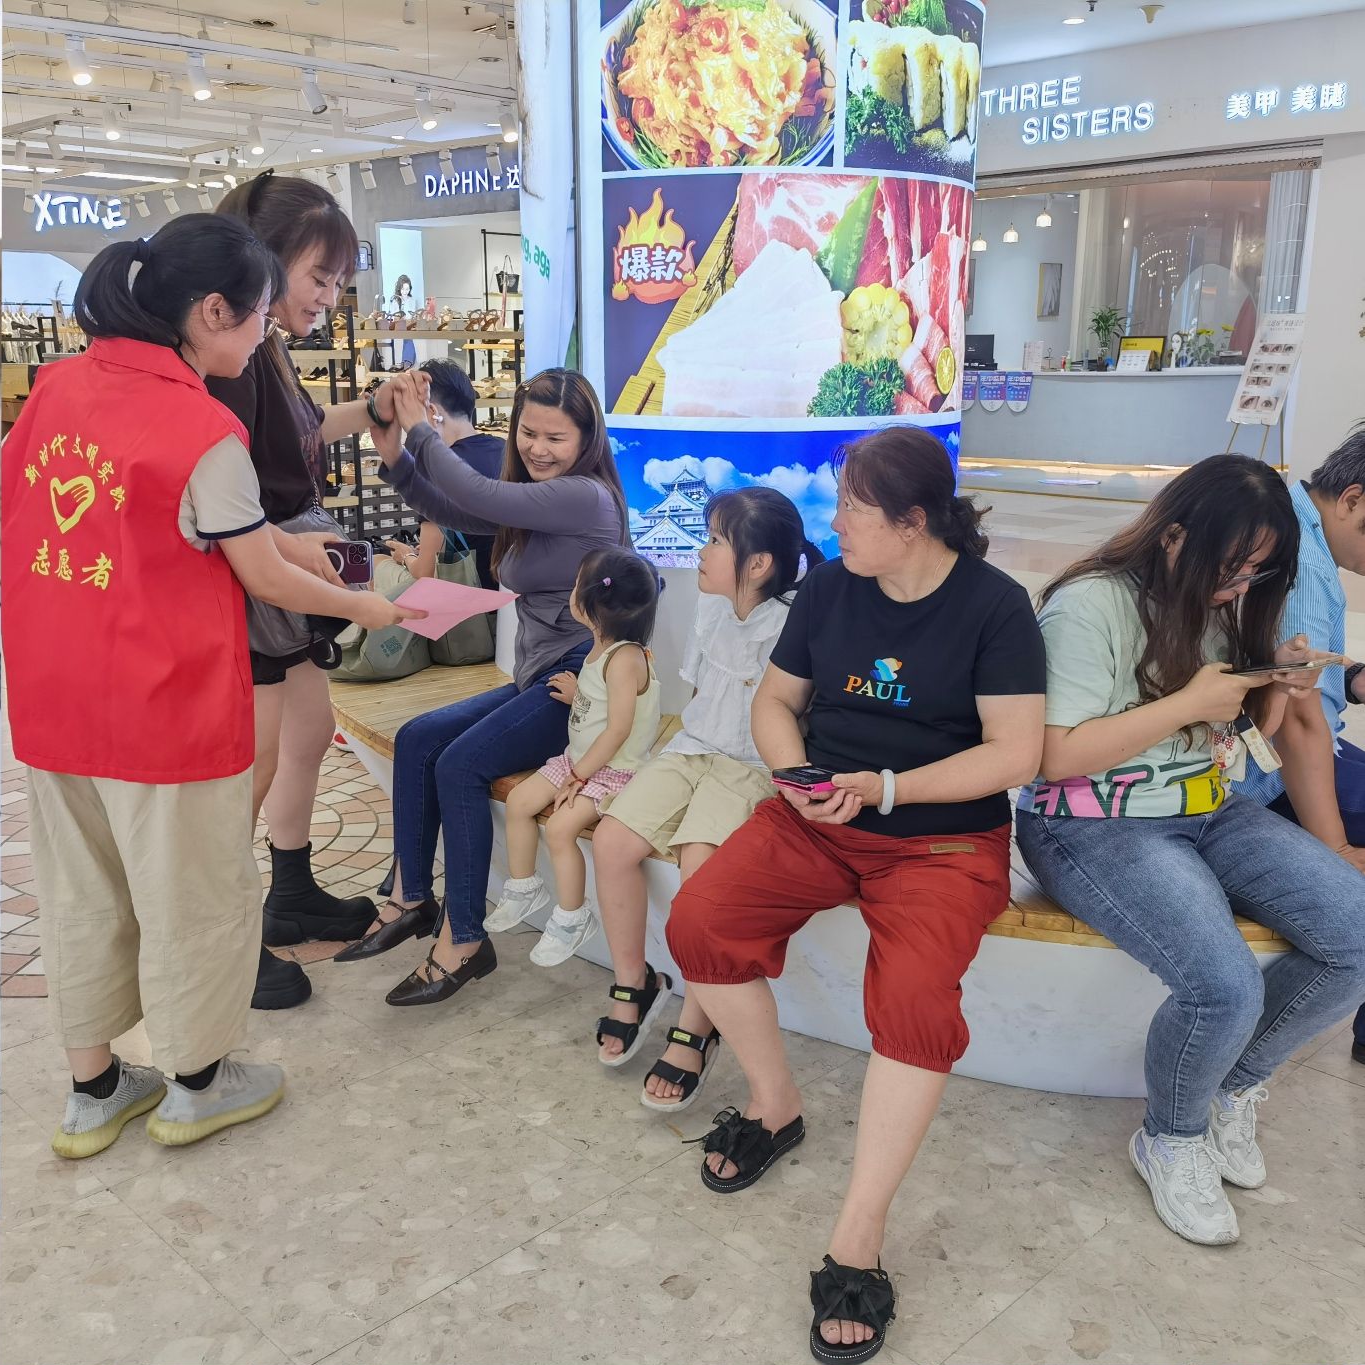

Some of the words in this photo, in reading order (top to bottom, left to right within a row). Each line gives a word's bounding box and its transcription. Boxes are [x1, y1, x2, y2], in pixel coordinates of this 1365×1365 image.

[980, 75, 1082, 117] THREE
[1225, 89, 1280, 120] 美甲
[1021, 101, 1155, 146] SISTERS
[423, 167, 502, 198] DAPHNE
[619, 244, 684, 283] 爆款
[31, 538, 114, 591] 志愿者
[842, 674, 912, 703] PAUL
